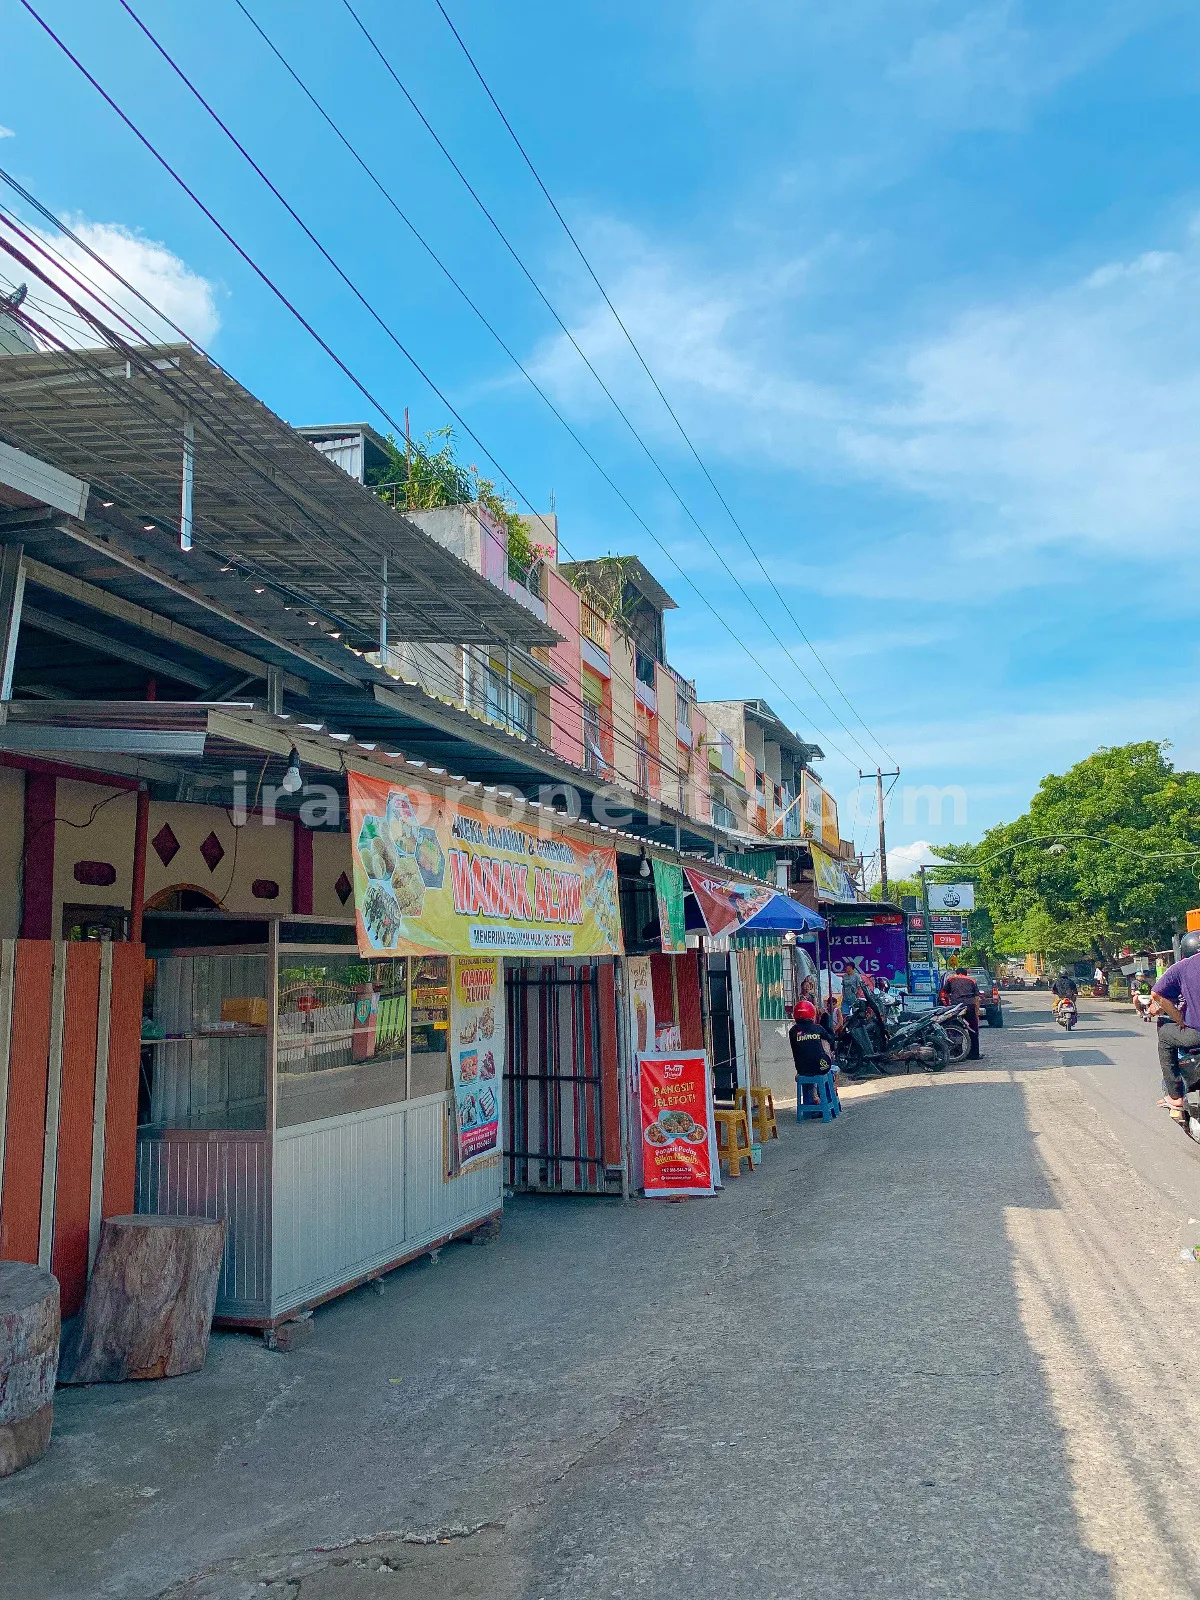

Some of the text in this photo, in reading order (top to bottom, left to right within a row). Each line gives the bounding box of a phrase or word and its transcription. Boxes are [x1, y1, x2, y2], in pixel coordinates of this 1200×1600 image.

[528, 834, 535, 856] &
[448, 848, 533, 922] MAMAK
[844, 935, 872, 945] CELL
[461, 967, 494, 988] MAMAK
[653, 1081, 695, 1096] PANGSIT
[653, 1094, 696, 1108] JELETOT!
